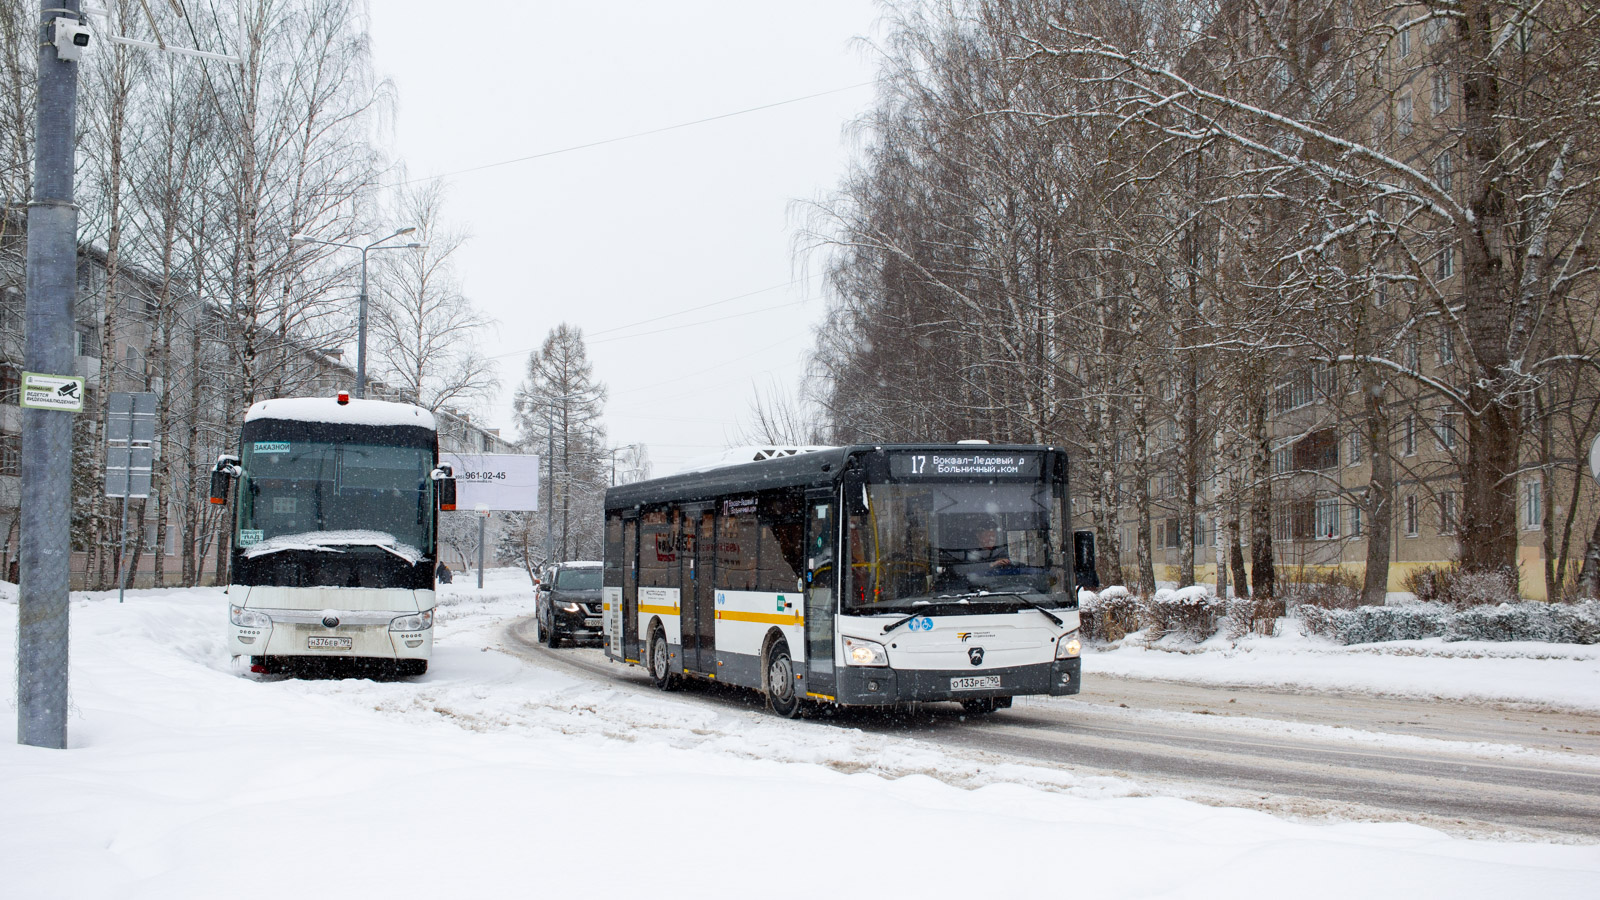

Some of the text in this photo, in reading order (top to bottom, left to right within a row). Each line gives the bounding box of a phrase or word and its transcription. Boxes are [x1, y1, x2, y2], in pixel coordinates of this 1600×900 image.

[255, 443, 290, 451] ЗАКАЗНОЙ
[911, 455, 926, 474] 17
[932, 455, 1014, 465] Вокзал-Ледовый
[938, 464, 1018, 473] Больничный.ком
[465, 471, 506, 480] 961-02-45
[952, 676, 999, 689] О133РЕ 790
